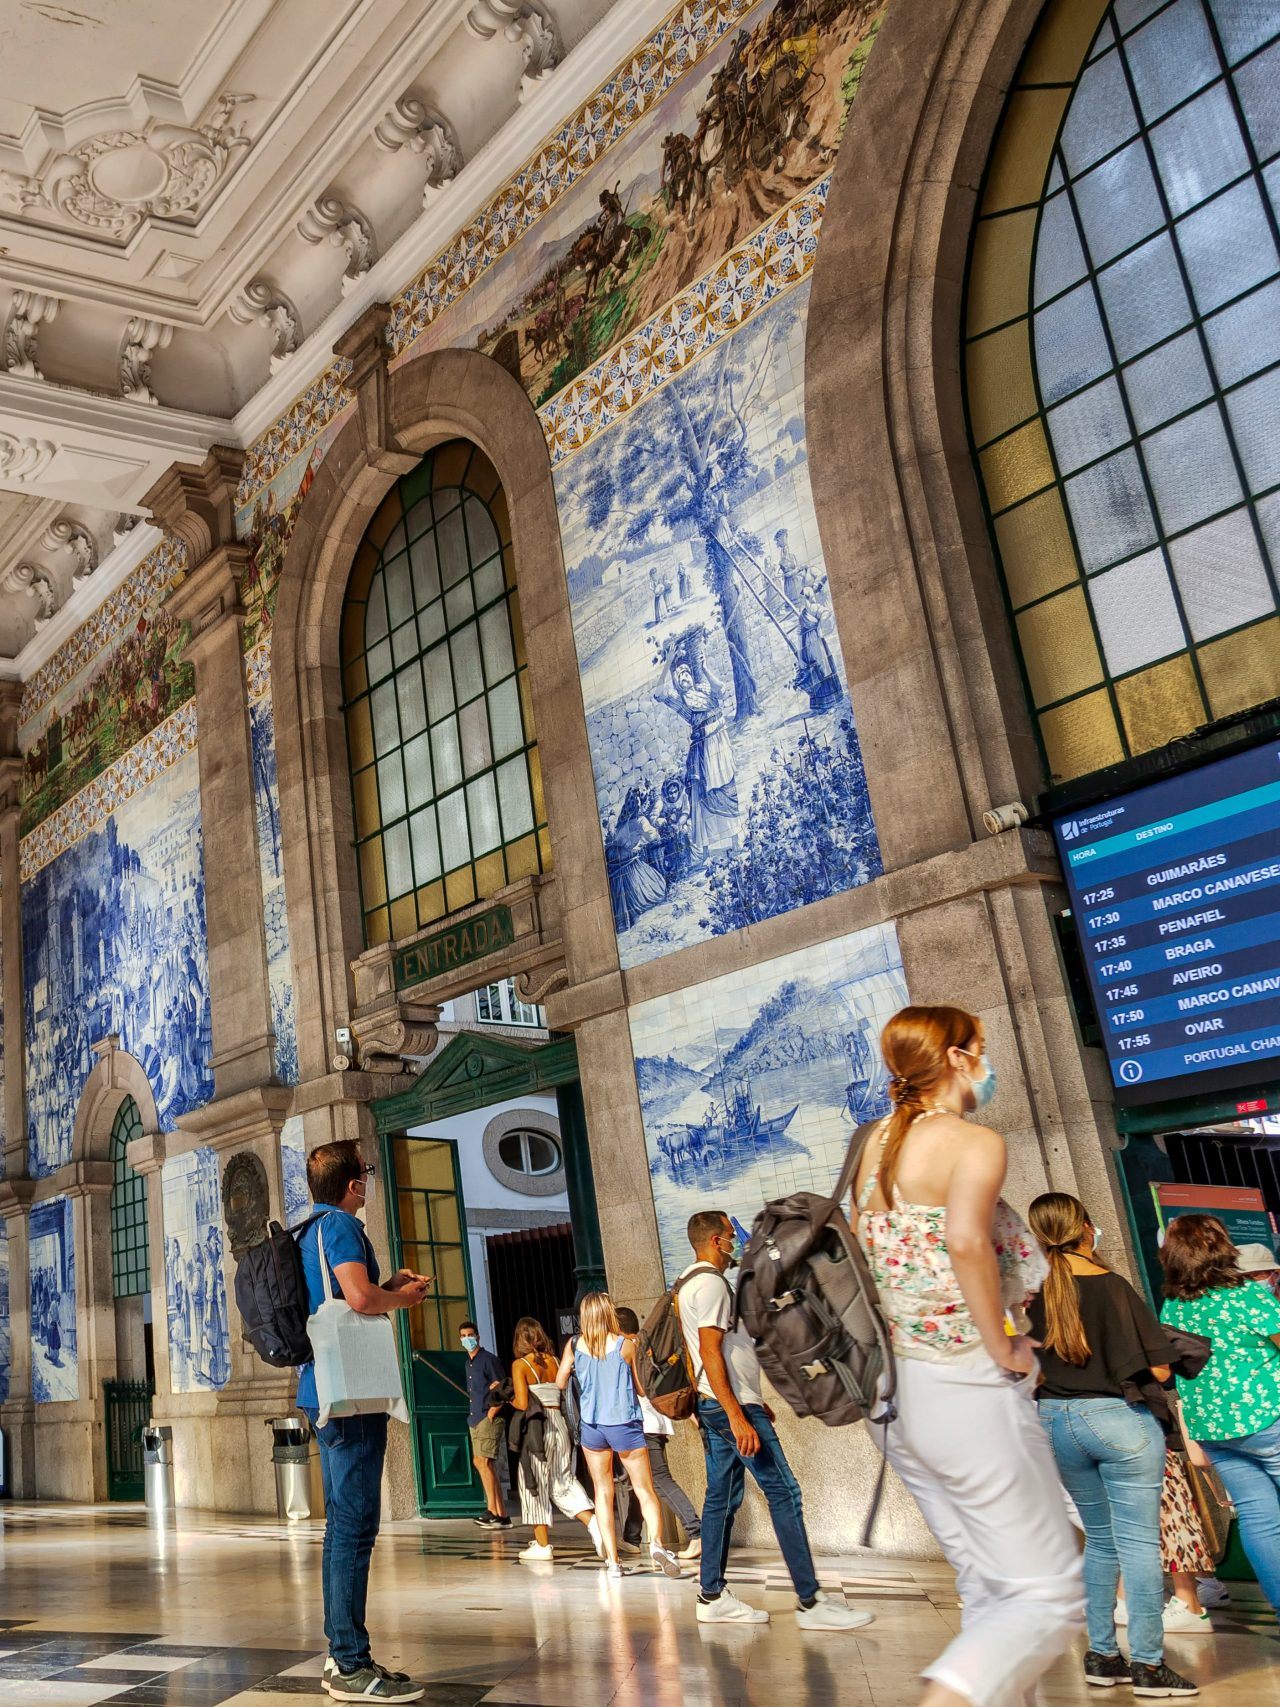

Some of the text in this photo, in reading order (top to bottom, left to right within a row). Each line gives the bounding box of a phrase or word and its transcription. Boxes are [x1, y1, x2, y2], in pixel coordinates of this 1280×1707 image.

[1078, 806, 1126, 828] Infraestruturas
[1089, 817, 1113, 830] Portugal
[1072, 822, 1174, 862] HORA DESTINO
[1082, 853, 1227, 906] 17:25 GUIMARÃES
[1088, 863, 1280, 929] 17:30 MARCO CANAVESE
[403, 912, 504, 980] ENTRADA
[1094, 908, 1226, 953] 17:35 PENAFIEL
[1100, 938, 1215, 977] 17:40 BRAGA
[1105, 963, 1223, 1001] 17:45 AVEIRO
[1111, 1009, 1145, 1026] 17:50
[1177, 989, 1229, 1011] MARCO
[1118, 1018, 1224, 1050] 17:55 OVAR
[1183, 1043, 1250, 1065] PORTUGAL
